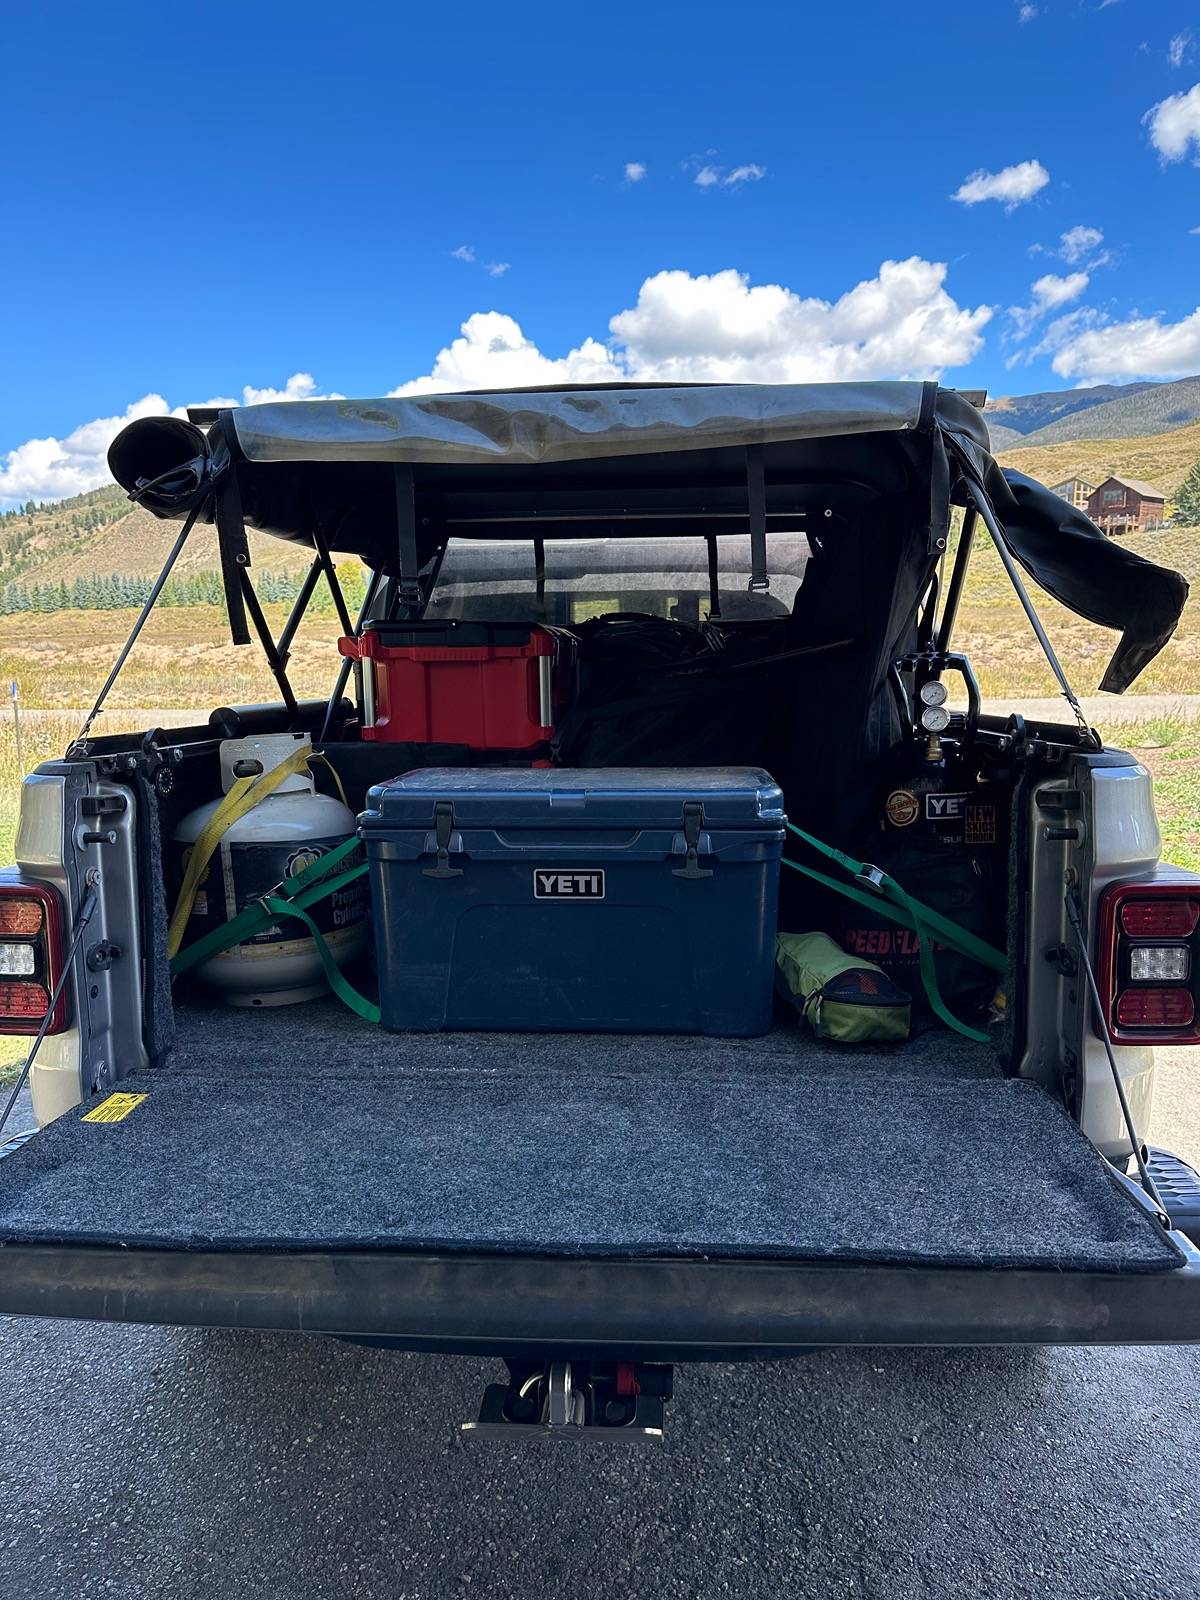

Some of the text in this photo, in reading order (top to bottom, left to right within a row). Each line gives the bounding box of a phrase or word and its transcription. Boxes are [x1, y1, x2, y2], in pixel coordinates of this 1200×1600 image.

[931, 798, 968, 815] YE
[966, 806, 995, 822] NEW
[538, 875, 598, 893] YETI
